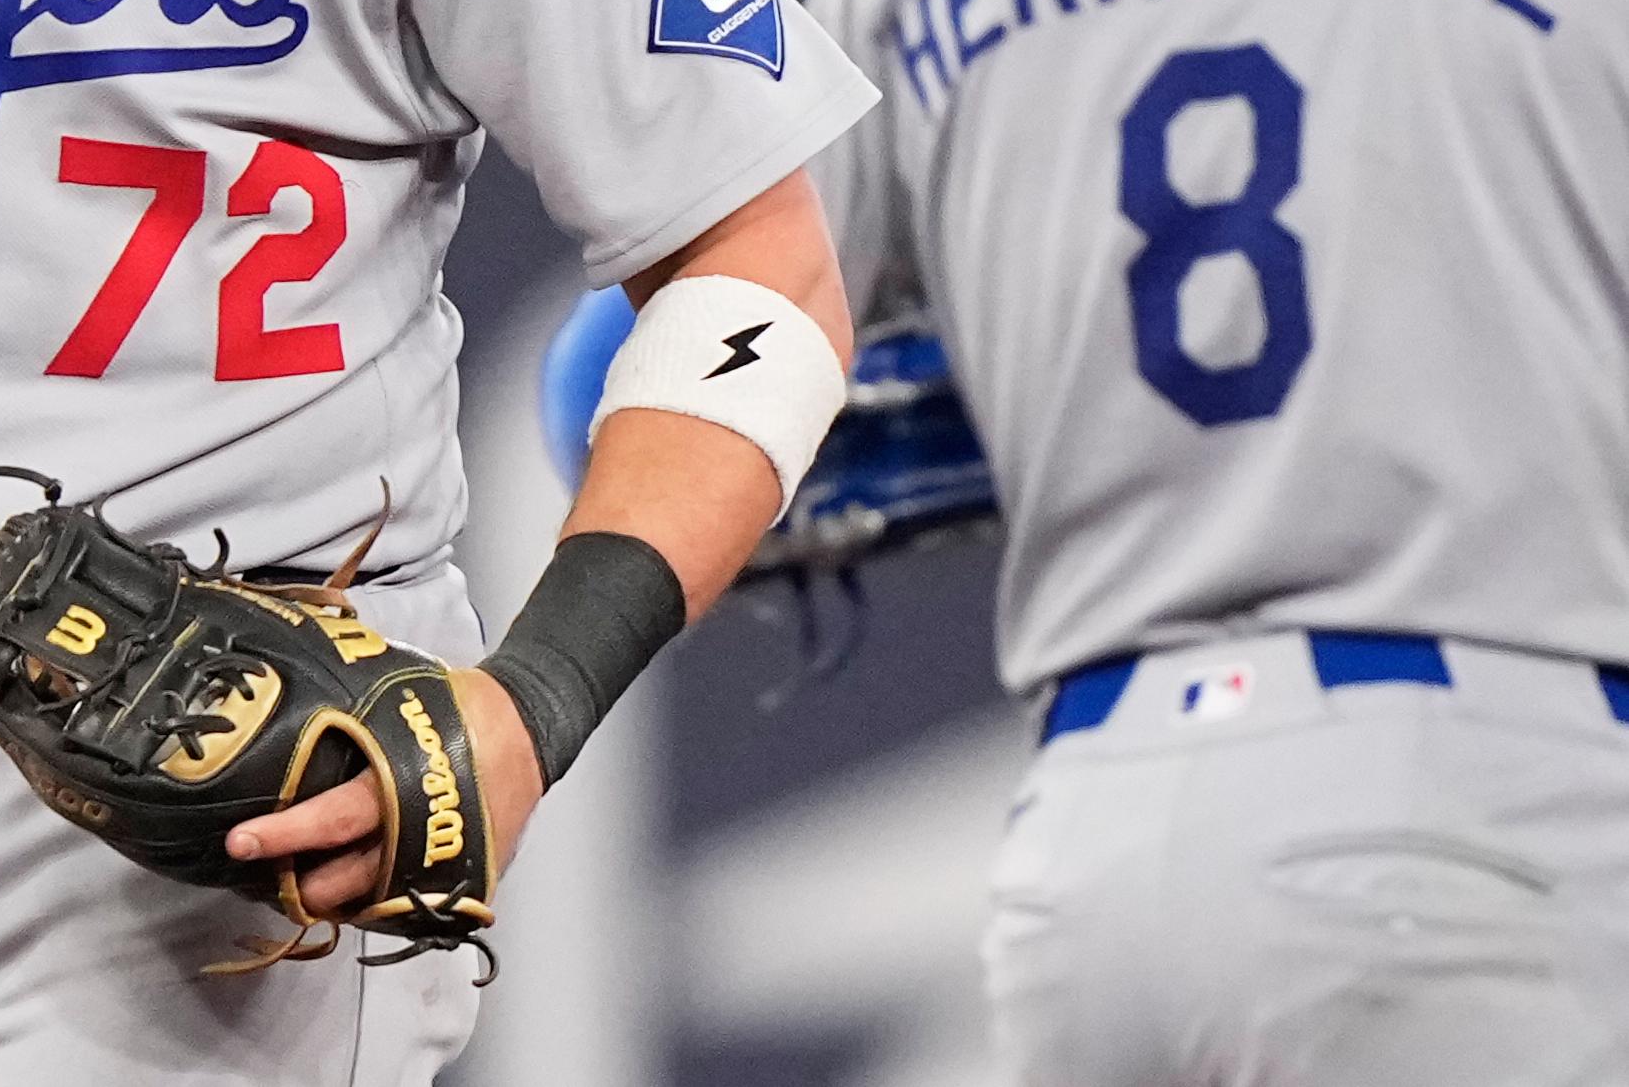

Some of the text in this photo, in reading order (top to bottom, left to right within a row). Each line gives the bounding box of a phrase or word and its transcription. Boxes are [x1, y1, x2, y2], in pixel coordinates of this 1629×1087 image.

[43, 133, 348, 382] 72
[1119, 43, 1313, 428] 8
[399, 697, 464, 868] Wilson
